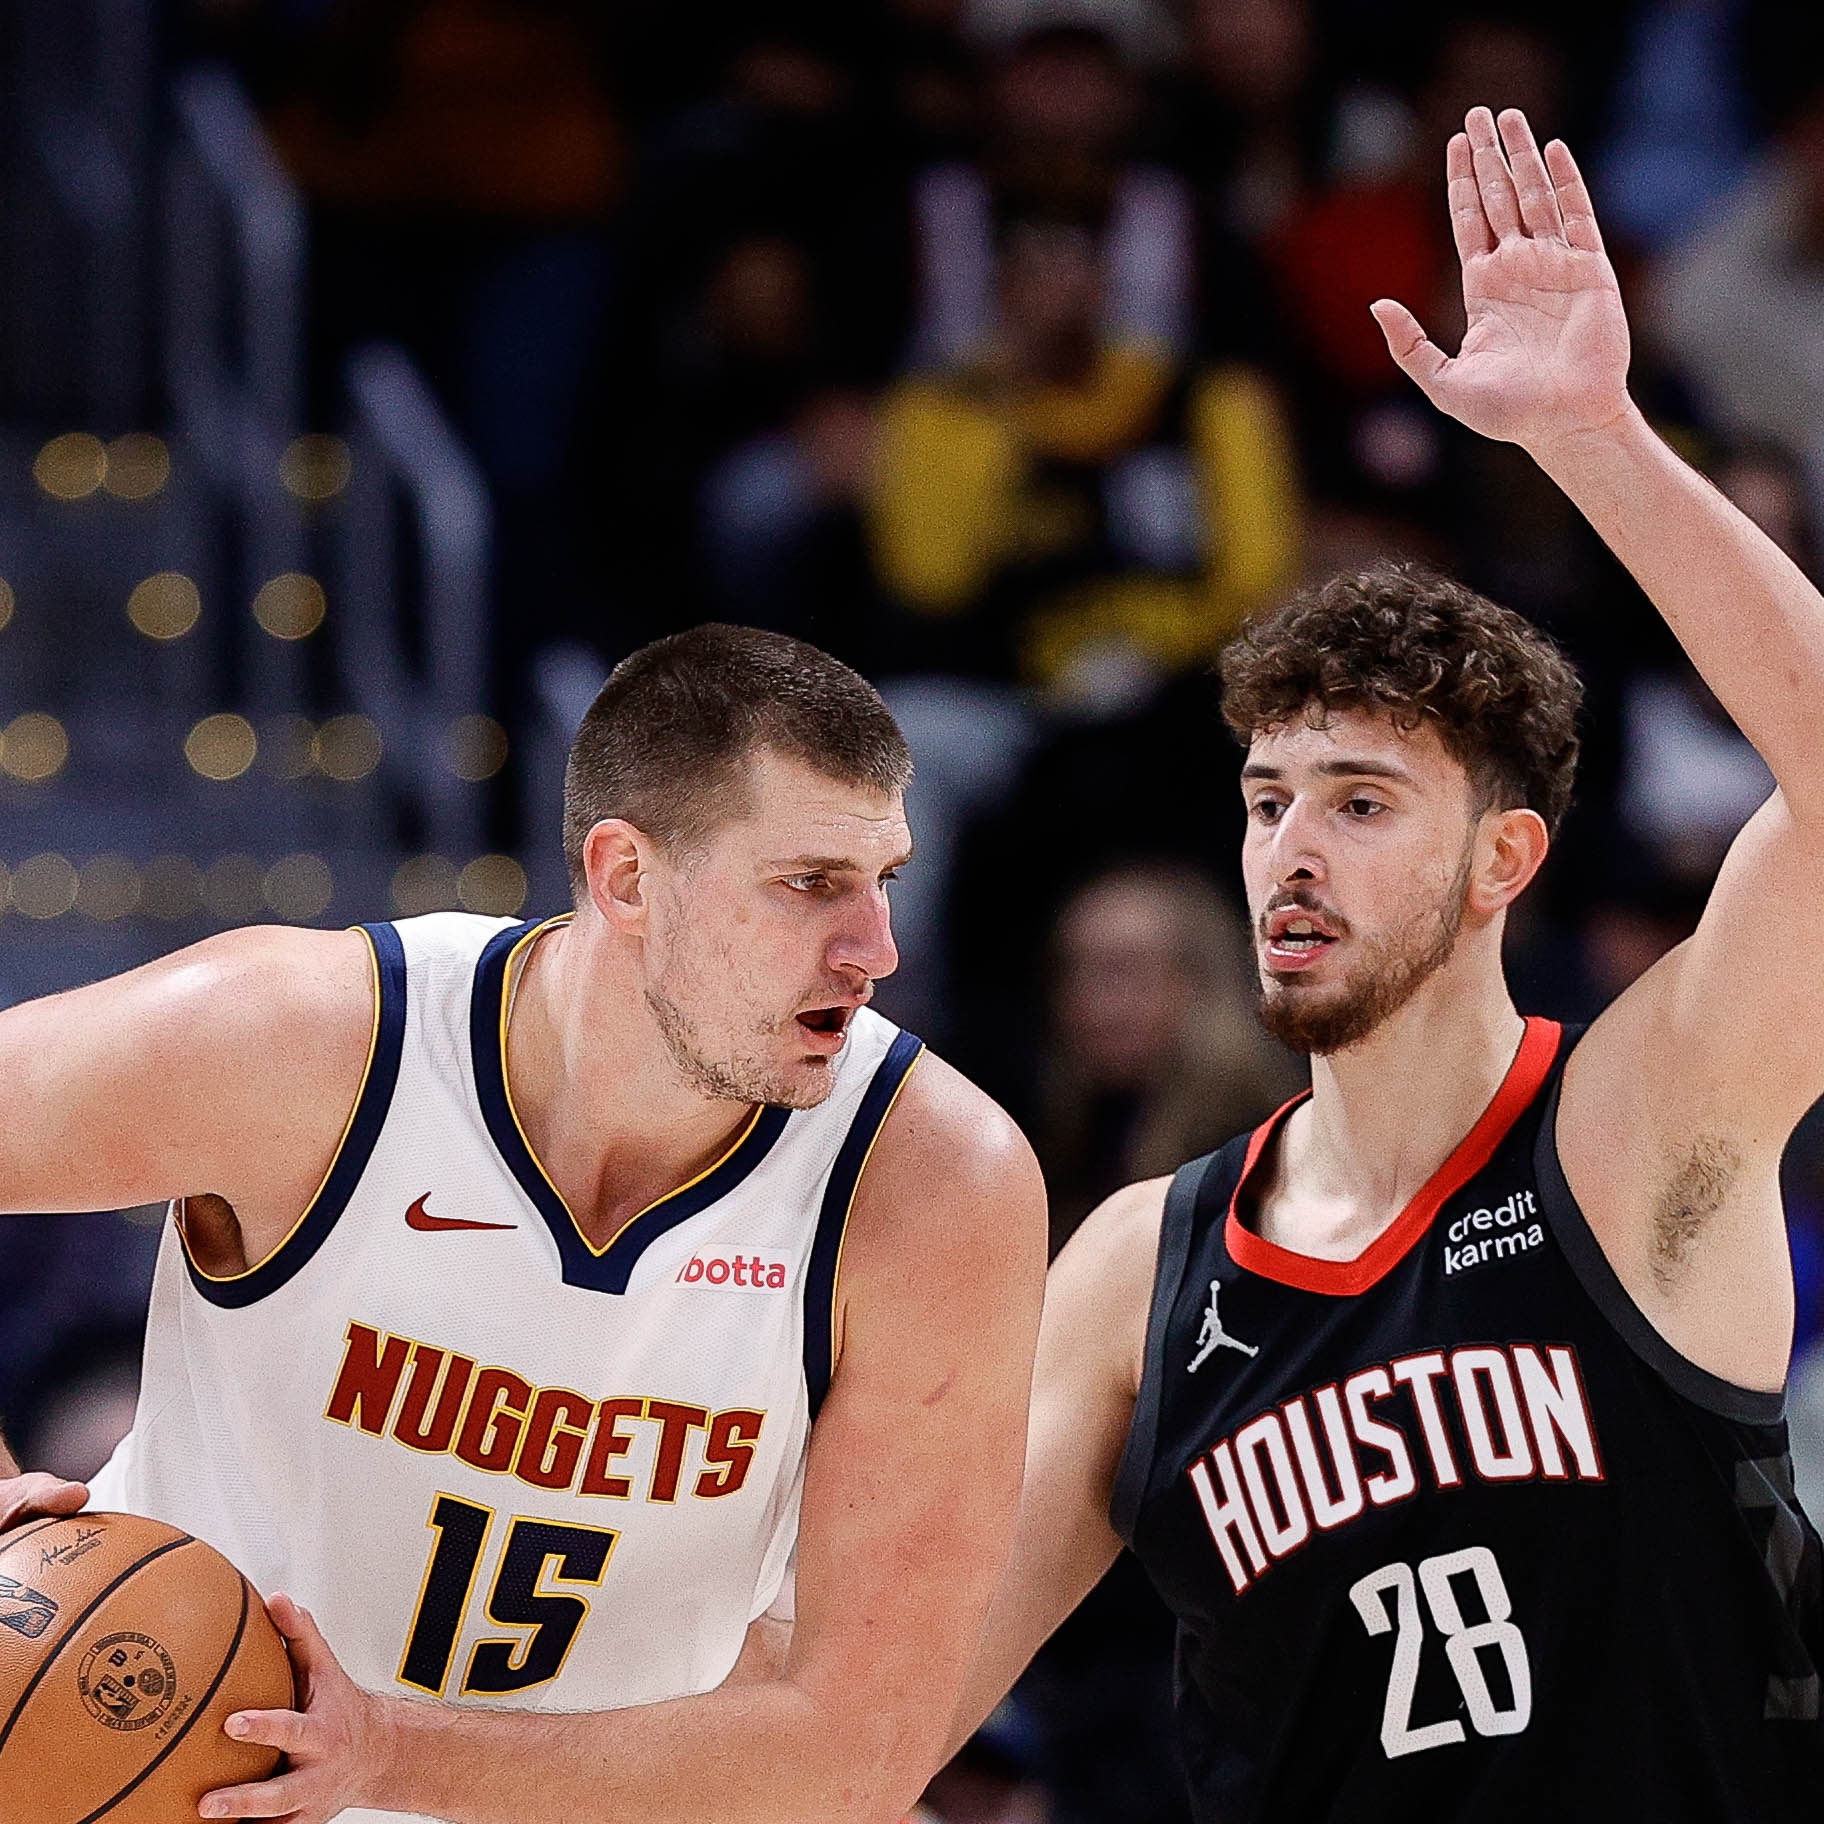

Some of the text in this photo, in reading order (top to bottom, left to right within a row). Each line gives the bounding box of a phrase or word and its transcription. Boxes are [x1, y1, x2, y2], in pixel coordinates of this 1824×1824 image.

[674, 1251, 787, 1289] botta
[1444, 1223, 1544, 1275] karma
[1448, 1190, 1537, 1243] credit
[323, 1317, 768, 1505] NUGGETS
[1185, 1341, 1606, 1597] HOUSTON
[396, 1491, 621, 1698] 15
[1349, 1546, 1532, 1759] 28
